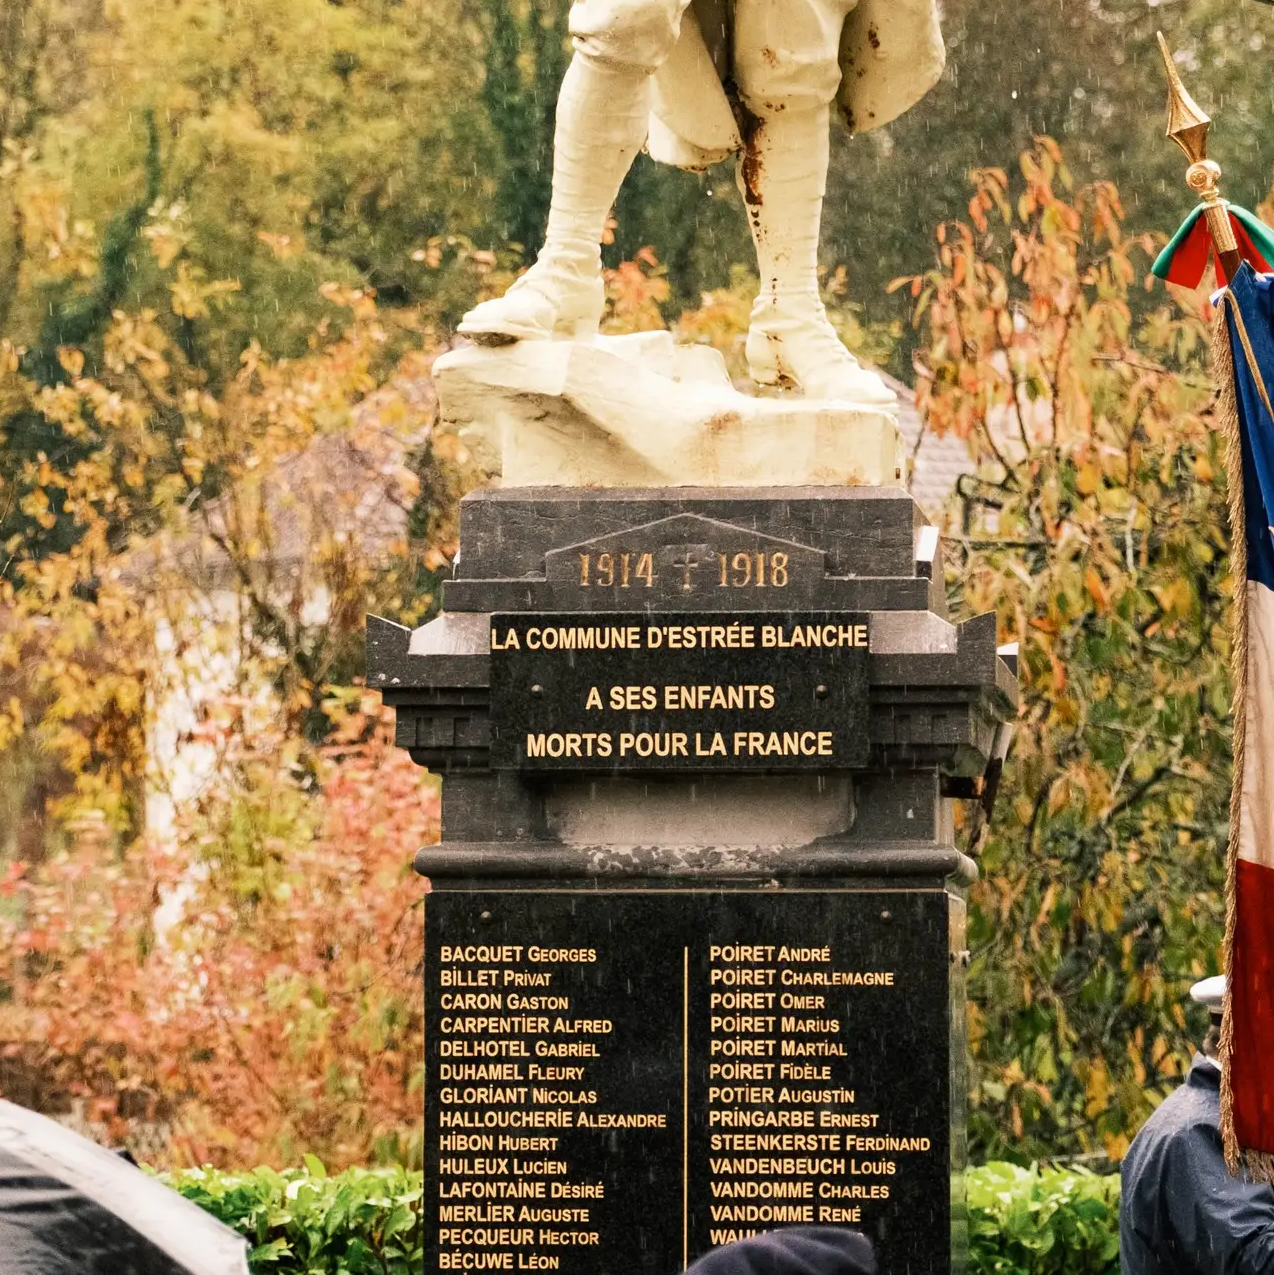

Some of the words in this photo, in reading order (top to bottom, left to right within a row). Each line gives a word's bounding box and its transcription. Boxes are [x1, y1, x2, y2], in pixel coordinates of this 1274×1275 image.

[578, 553, 659, 587] 1914
[716, 552, 789, 588] 1918
[491, 627, 521, 650] LA
[526, 626, 641, 650] COMMUNE
[647, 621, 755, 649] D'ESTRÉE
[761, 625, 868, 648] BLANCHE
[585, 686, 604, 710] A
[609, 685, 658, 711] SES
[664, 684, 775, 710] ENFANTS
[526, 732, 613, 758] MORTS
[619, 732, 689, 757] POUR
[695, 732, 728, 756] LA
[733, 731, 833, 756] FRANCE
[441, 946, 523, 963] BACQUET
[528, 946, 597, 962] GEORGES
[777, 945, 831, 962] ANDRÉ
[781, 969, 894, 986] CHARLEMAGNE
[441, 993, 502, 1010] CARON
[507, 993, 569, 1010] GASTON
[781, 993, 825, 1010] OMER
[553, 1017, 613, 1033] ALFRED
[440, 1040, 530, 1057] DELHOTEL
[440, 1063, 524, 1080] DUHAMEL
[528, 1063, 585, 1080] FLEURY
[576, 1111, 667, 1128] ALEXANDRE
[820, 1111, 879, 1127] ERNEST
[498, 1134, 558, 1151] HUBERT
[710, 1134, 841, 1151] STEENKERSTE
[439, 1158, 509, 1174] HULEUX
[710, 1157, 845, 1175] VANDENBEUCH
[710, 1181, 814, 1198] VANDOMME
[818, 1182, 890, 1199] CHARLES
[518, 1205, 590, 1222] AUGUSTE
[710, 1205, 814, 1222] VANDOMME
[819, 1205, 861, 1222] RENÉ
[439, 1229, 534, 1246] PECQUEUR
[539, 1229, 599, 1245] HECTOR
[439, 1248, 514, 1269] BÉCUWE
[518, 1253, 559, 1269] LÉON
